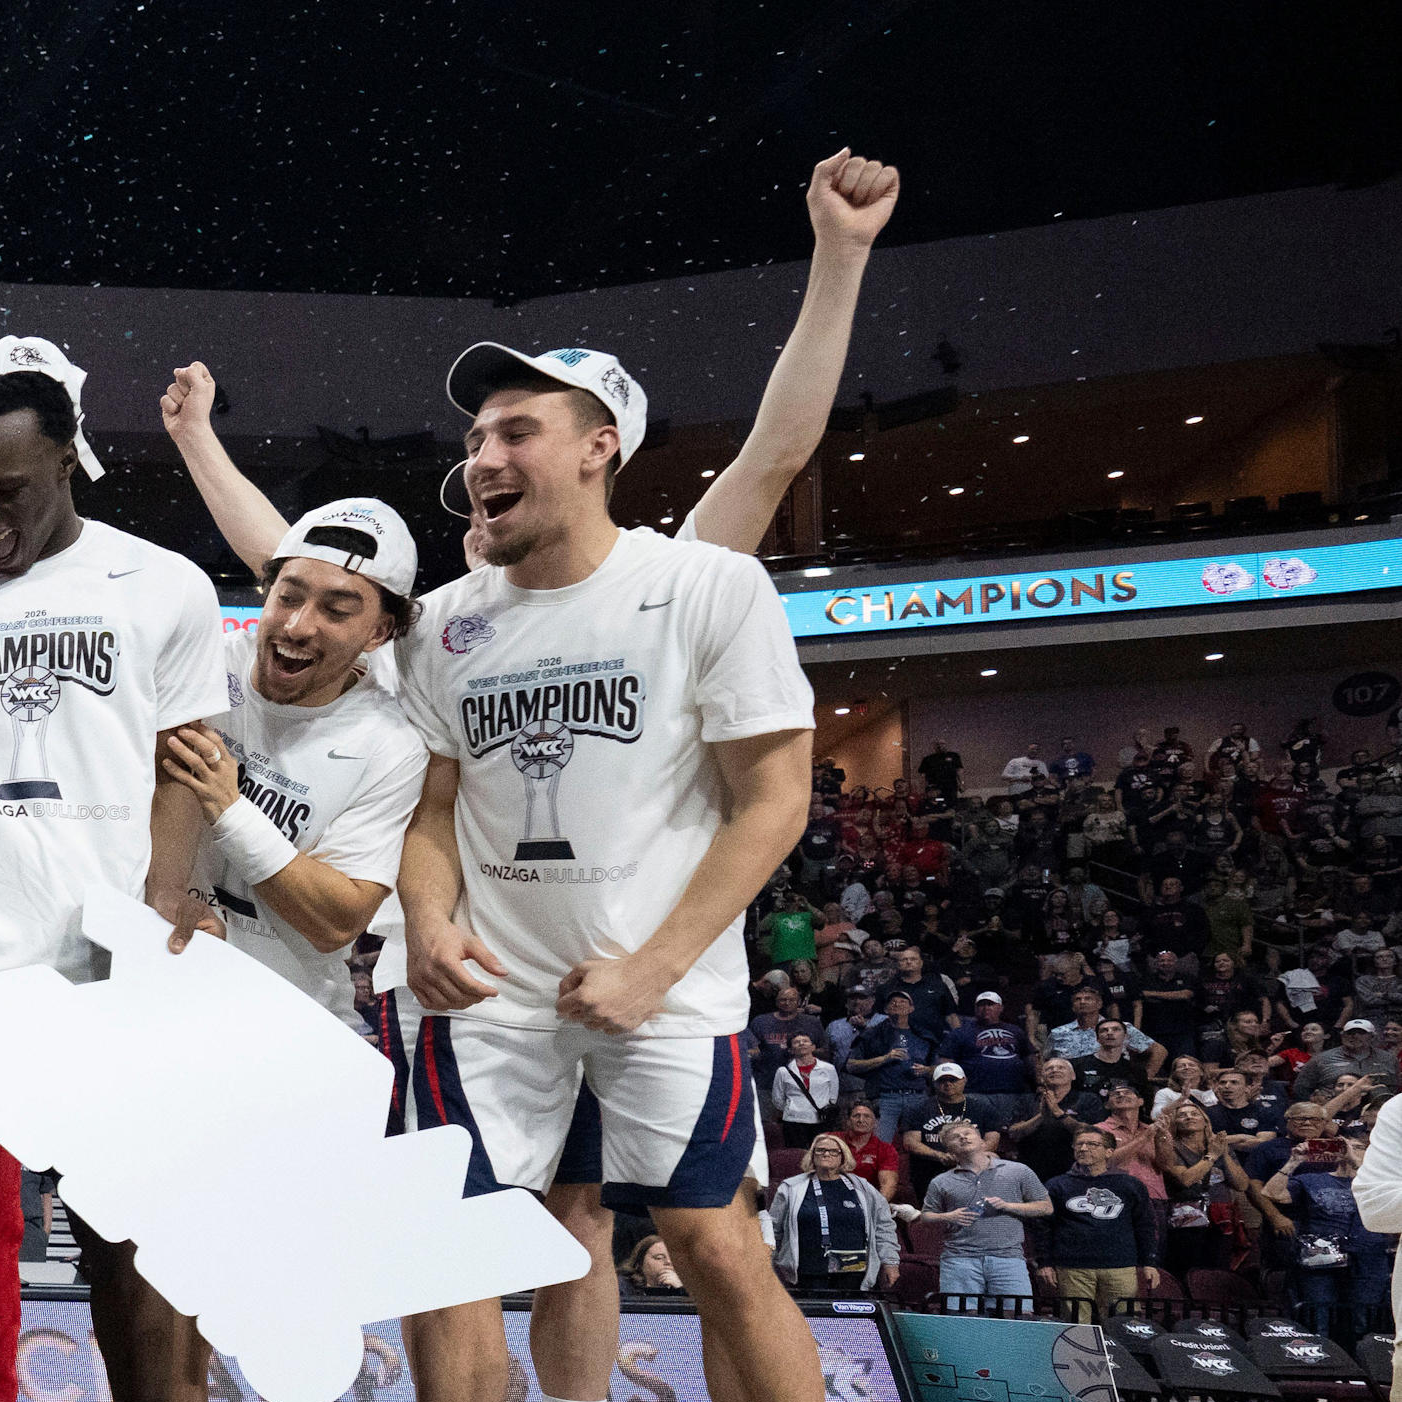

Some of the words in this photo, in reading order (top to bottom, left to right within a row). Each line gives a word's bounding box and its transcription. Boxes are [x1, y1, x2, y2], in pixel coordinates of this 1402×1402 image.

[824, 570, 1138, 626] CHAMPIONS
[25, 610, 47, 618] 2026
[28, 616, 103, 629] CONFERENCE
[537, 656, 562, 668] 2026
[468, 676, 499, 690] WEST
[500, 670, 541, 685] COAST
[541, 658, 625, 680] CONFERENCE
[8, 684, 53, 702] WCC
[1343, 683, 1391, 704] 107
[461, 675, 639, 749] CHAMPIONS
[520, 738, 566, 757] WCC
[249, 751, 271, 765] 2026
[247, 760, 310, 796] CONFERENCE
[33, 802, 132, 821] BULLDOGS
[1126, 1324, 1154, 1336] WCC
[1198, 1327, 1225, 1338] WCC
[1266, 1323, 1296, 1335] WCC
[1170, 1339, 1199, 1349] Credit
[1373, 1335, 1396, 1344] Cre
[1286, 1346, 1325, 1358] WCC
[1195, 1352, 1233, 1371] WCC
